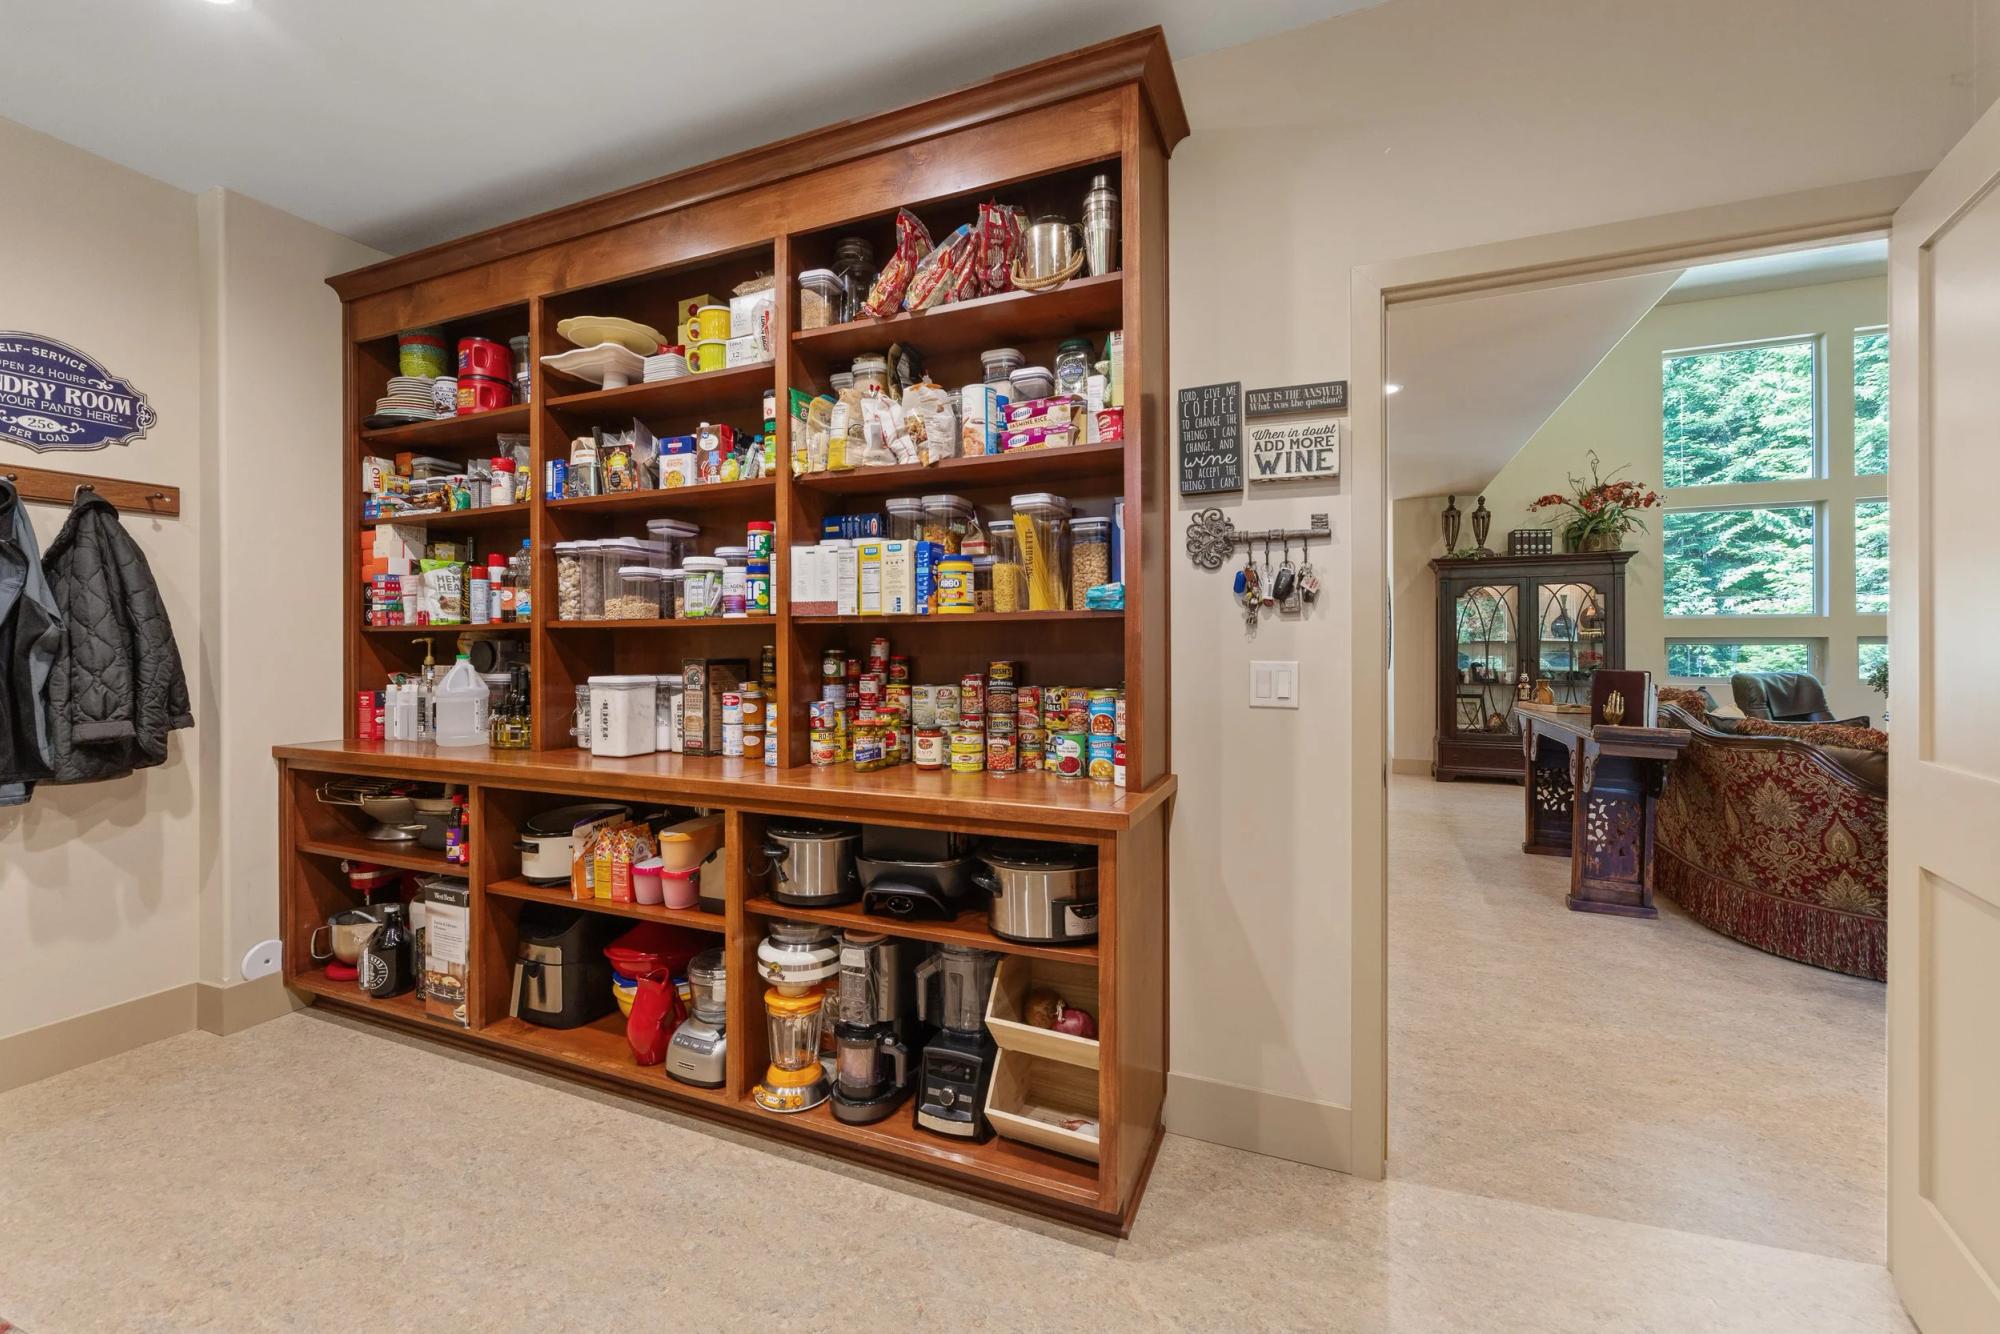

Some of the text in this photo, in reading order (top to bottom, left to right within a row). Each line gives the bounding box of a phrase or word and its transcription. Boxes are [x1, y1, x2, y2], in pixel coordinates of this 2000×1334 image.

[0, 359, 87, 385] PEN 24 HOURS
[1204, 386, 1220, 400] GIVE
[1226, 385, 1238, 397] ME
[1249, 386, 1343, 404] WINE IS THE ANSWER
[0, 393, 36, 408] YOUR
[40, 401, 82, 417] PANTS
[65, 387, 132, 416] ROOM
[1183, 397, 1234, 418] COFFEE
[1249, 402, 1270, 412] What
[1290, 398, 1304, 408] the
[1306, 395, 1342, 408] question?
[1182, 414, 1238, 430] TO CHANGE THE
[8, 425, 70, 442] PER LOAD
[1183, 426, 1237, 442] THINGS I CAN
[1252, 424, 1337, 440] When in doubt
[1219, 439, 1234, 450] AND
[1254, 436, 1334, 452] ADD MORE
[1184, 452, 1237, 468] wine
[1254, 448, 1334, 476] WINE
[1185, 465, 1237, 480] TO ACCEPT THE
[1182, 480, 1206, 492] THINGS
[1220, 475, 1241, 488] CAN'T
[940, 580, 960, 588] ARGO
